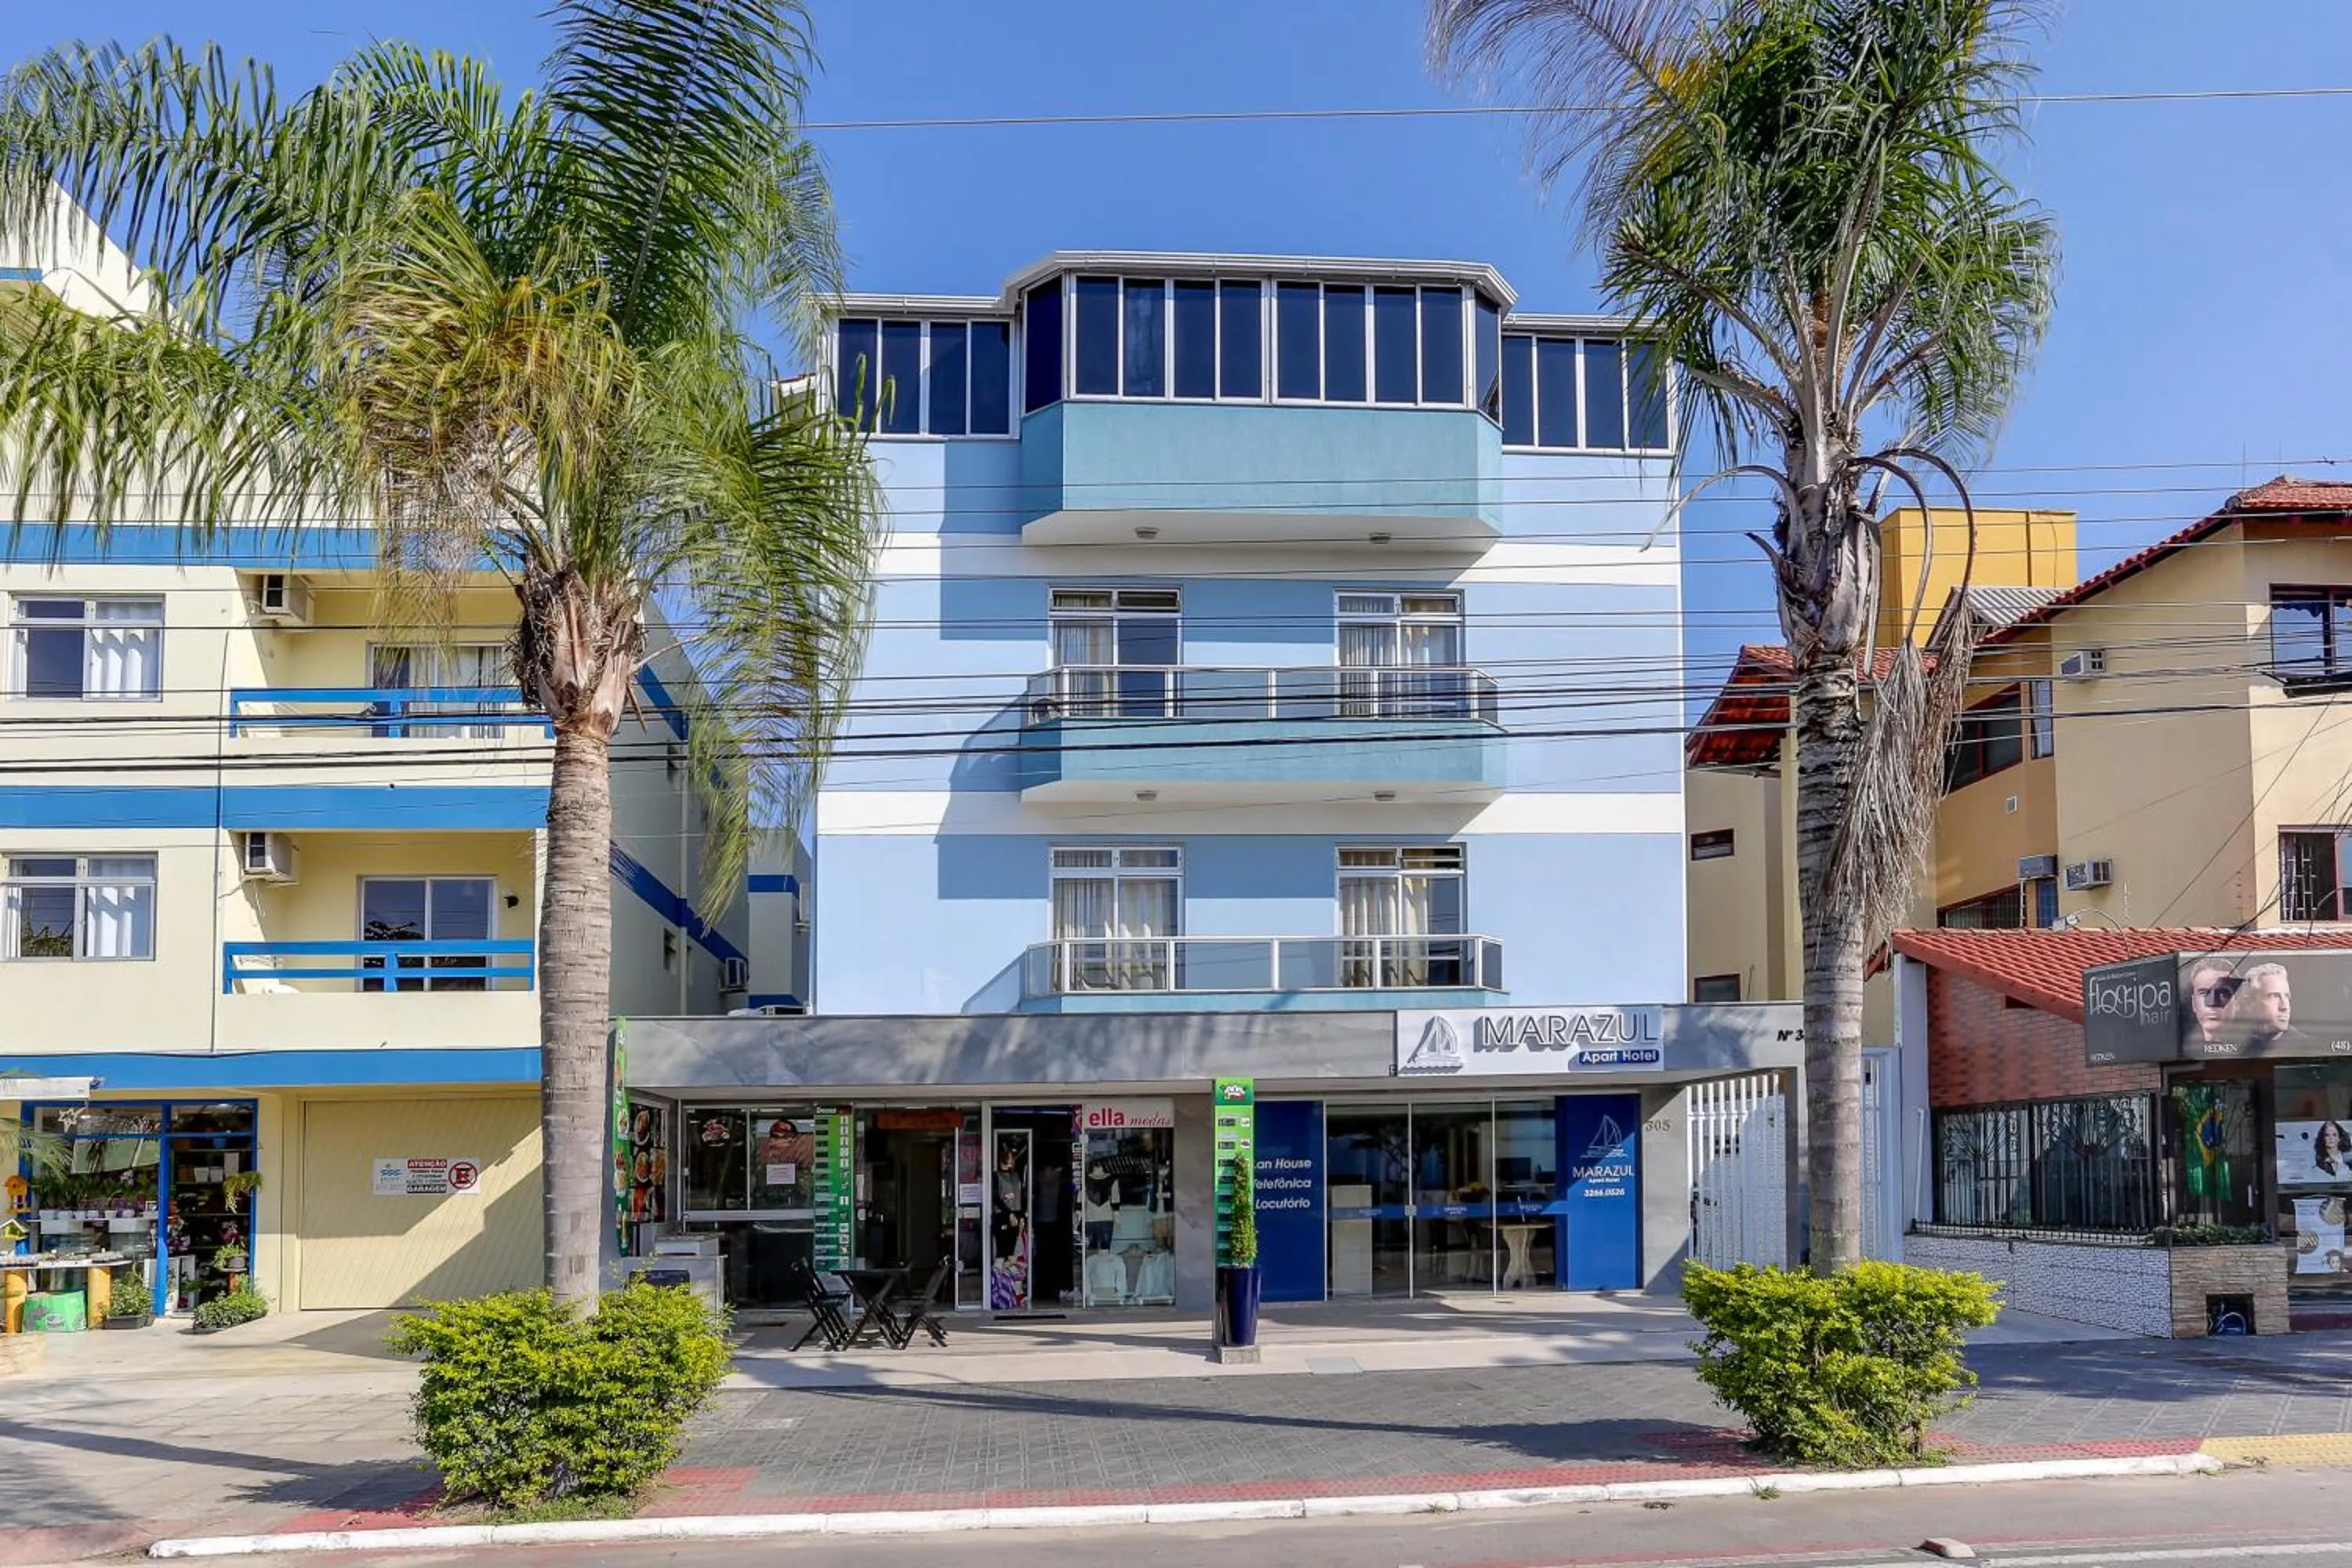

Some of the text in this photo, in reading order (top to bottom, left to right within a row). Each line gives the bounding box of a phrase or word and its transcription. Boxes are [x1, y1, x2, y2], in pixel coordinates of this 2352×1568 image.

[2089, 976, 2171, 1019] floripa
[2140, 1007, 2171, 1026] hair
[1483, 1013, 1658, 1044] MARAZUL
[1581, 1050, 1657, 1065] Apart Hotel
[1089, 1108, 1125, 1127] ella
[1254, 1158, 1312, 1170] an House
[1572, 1164, 1635, 1178] MARAZUL
[1256, 1197, 1311, 1210] Locutório
